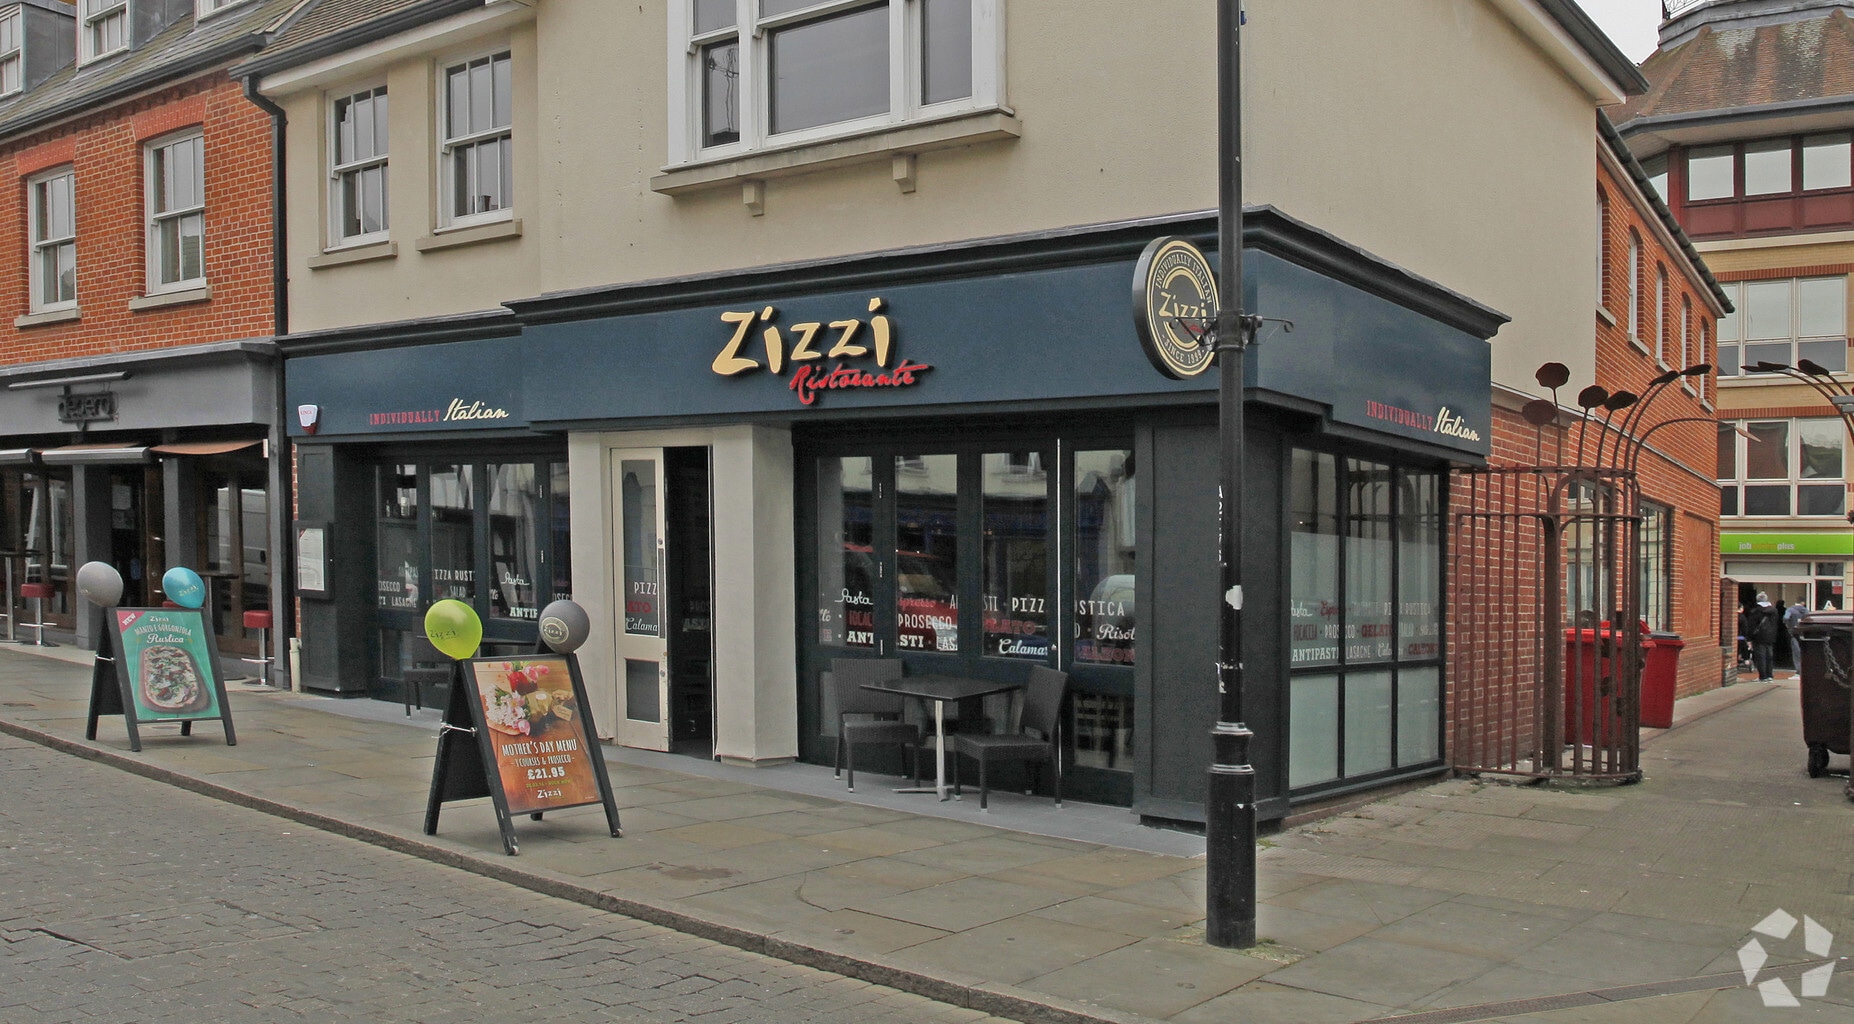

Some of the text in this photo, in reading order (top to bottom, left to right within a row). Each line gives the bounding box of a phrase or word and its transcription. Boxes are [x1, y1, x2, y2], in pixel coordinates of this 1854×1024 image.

[1155, 253, 1213, 304] INDIVIDUALLY ITALIAN
[1158, 291, 1207, 323] Zizzi
[711, 297, 890, 375] Zizzi
[1163, 339, 1185, 363] SINCE
[789, 359, 929, 405] Ristorante
[369, 397, 510, 426] INDIVIDUALLY Italian
[1366, 400, 1481, 442] INDIVIDUALLY Italian
[500, 571, 530, 586] Pasta
[634, 581, 657, 595] PIZZ
[834, 587, 873, 606] Pasta
[1012, 597, 1045, 613] PIZZ
[122, 613, 136, 626] NEW
[898, 613, 952, 630] PROSECCO
[146, 633, 184, 644] Rustica
[898, 634, 924, 648] STI
[1291, 647, 1339, 661] ANTIPASTI
[539, 740, 555, 754] DAY
[555, 738, 578, 753] MENU
[547, 753, 572, 765] PROSECCO
[527, 766, 566, 780] £21.95
[536, 788, 562, 799] Zizzi
